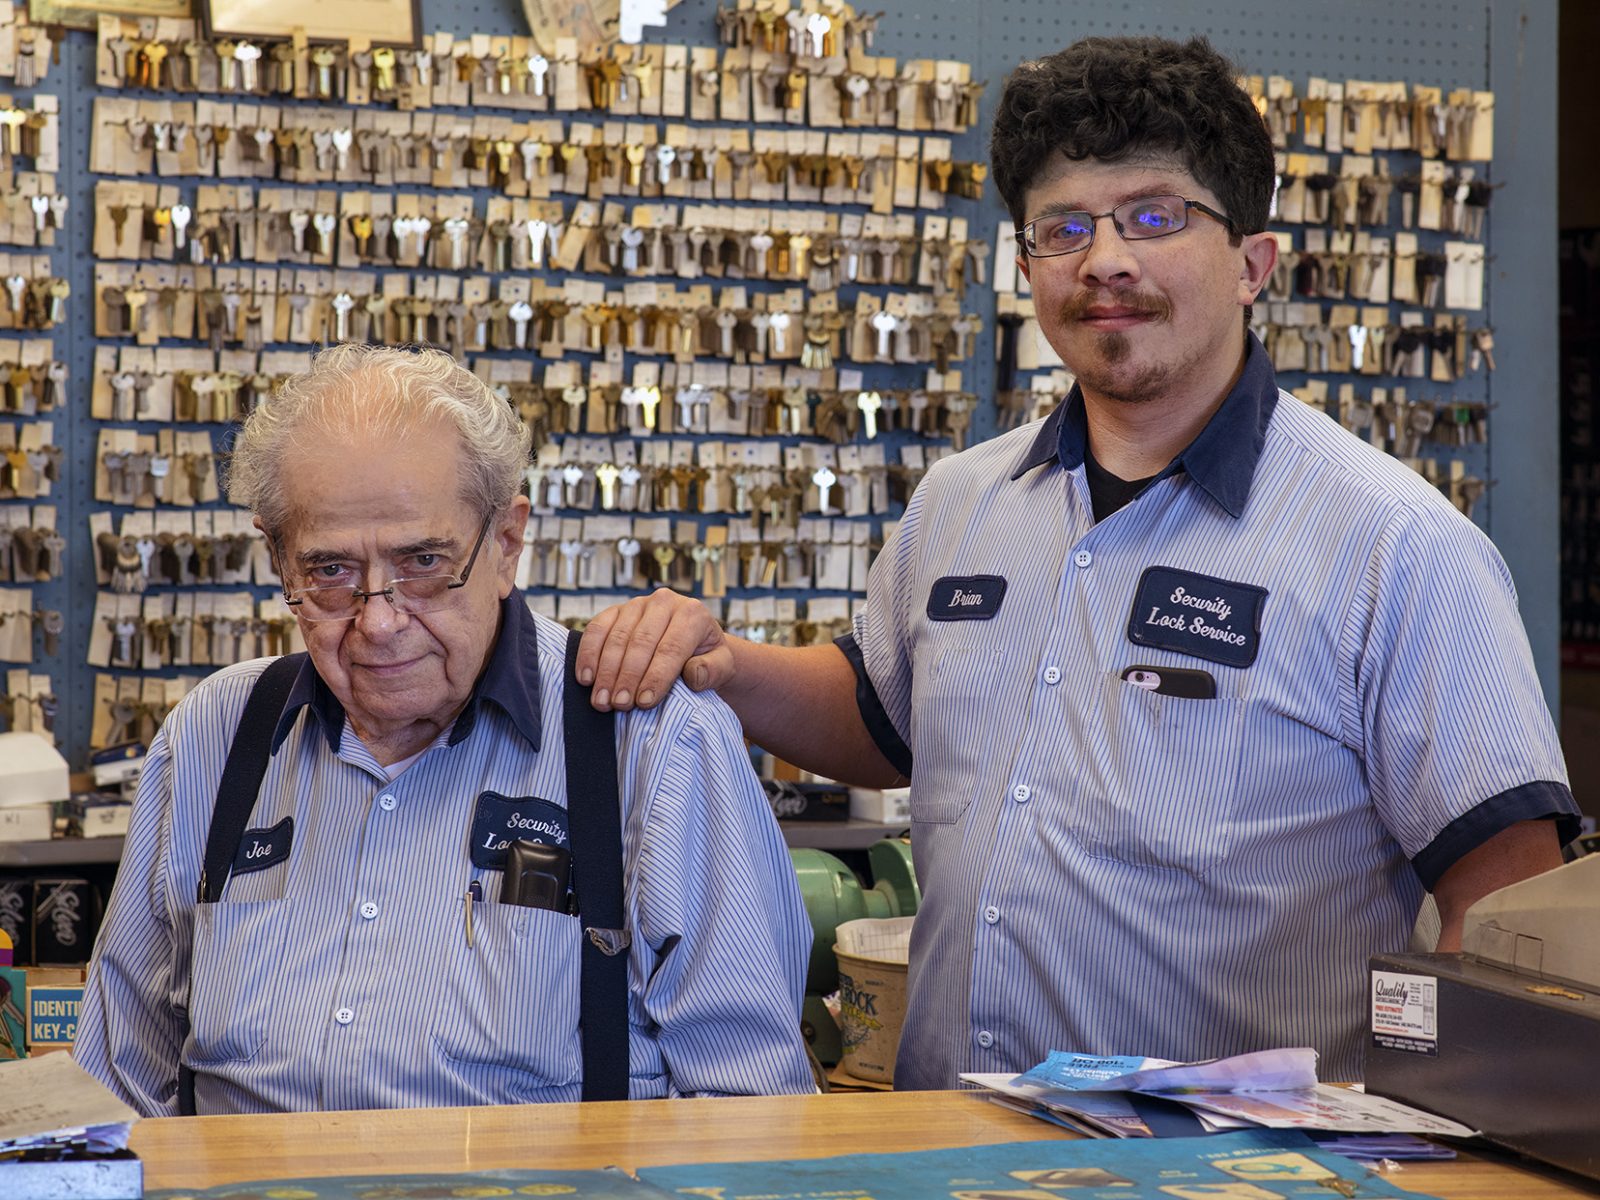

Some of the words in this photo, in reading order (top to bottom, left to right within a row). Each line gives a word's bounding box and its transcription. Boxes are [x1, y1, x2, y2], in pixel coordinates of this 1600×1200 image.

[948, 589, 984, 607] Brian
[1170, 586, 1232, 621] Security
[1145, 606, 1187, 631] Lock
[1188, 616, 1247, 646] Service
[507, 812, 567, 845] Security
[246, 840, 273, 859] Joe
[1375, 978, 1409, 1007] Quality
